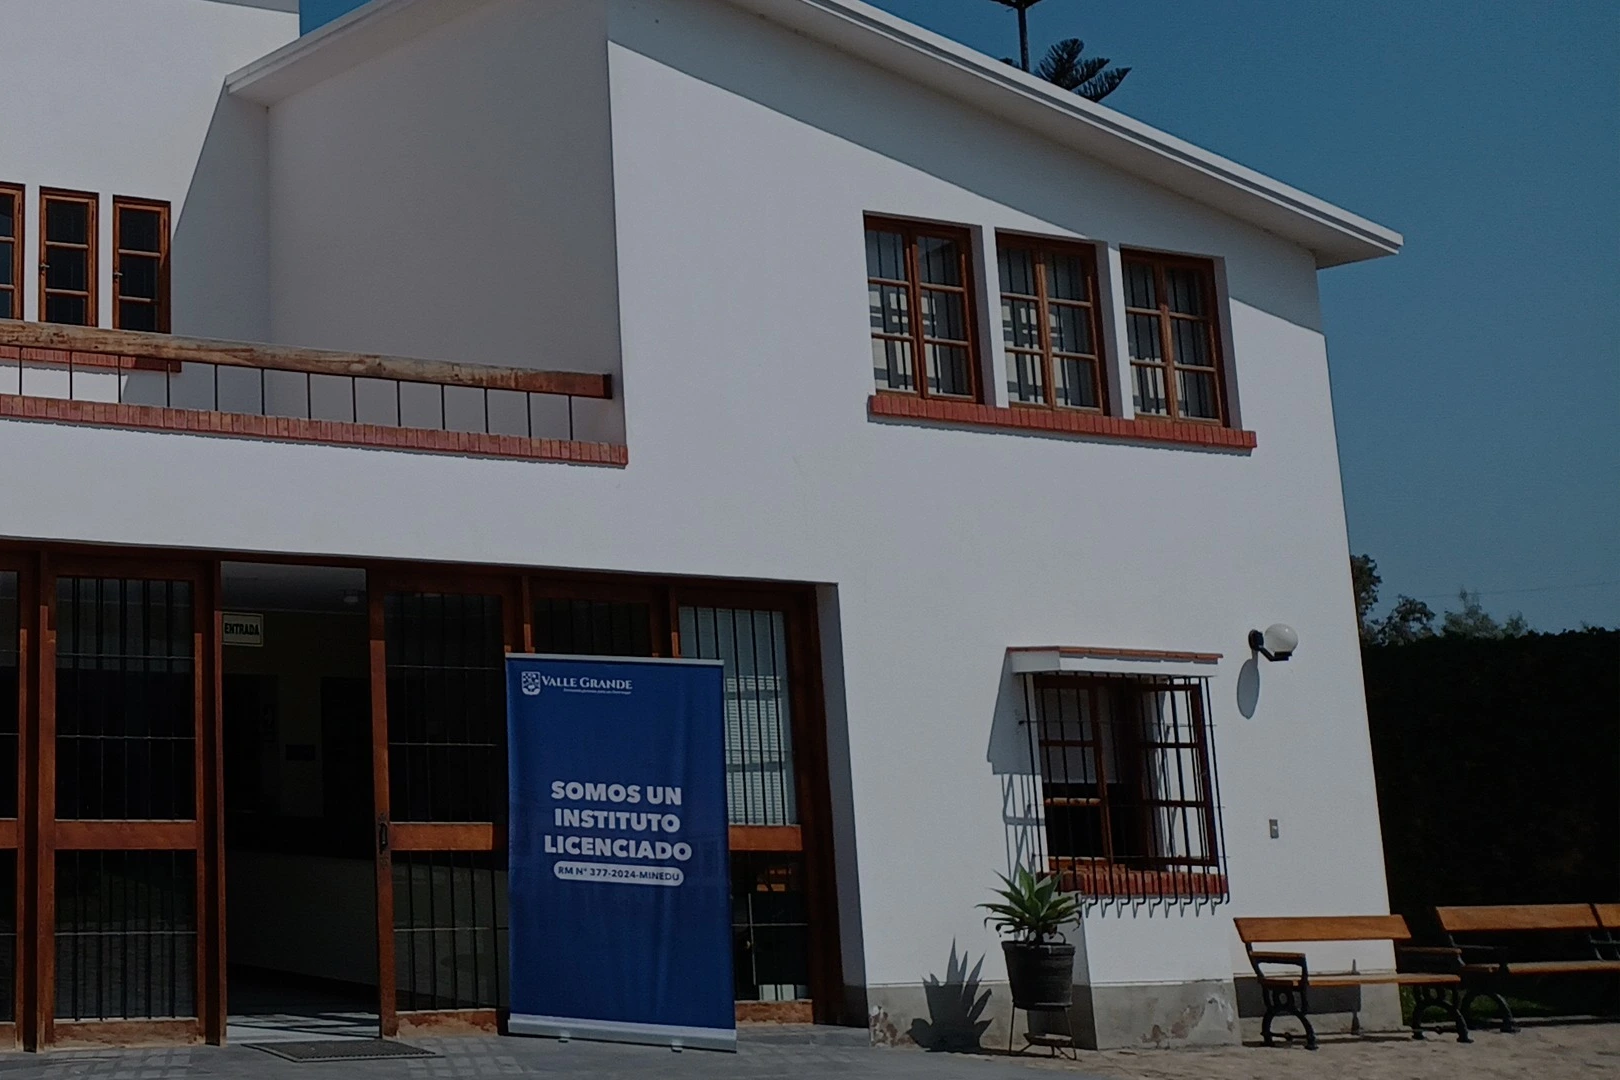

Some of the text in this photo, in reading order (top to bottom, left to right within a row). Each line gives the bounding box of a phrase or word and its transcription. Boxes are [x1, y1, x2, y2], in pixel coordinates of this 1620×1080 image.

[224, 622, 260, 635] ENTRADA
[541, 676, 632, 689] VALLE GRANDE
[551, 781, 682, 805] SOMOS UN
[554, 808, 681, 833] INSTITUTO
[544, 835, 692, 861] LICENCIADO
[558, 866, 573, 875] RM
[589, 868, 680, 881] 377-2024-MINEDU
